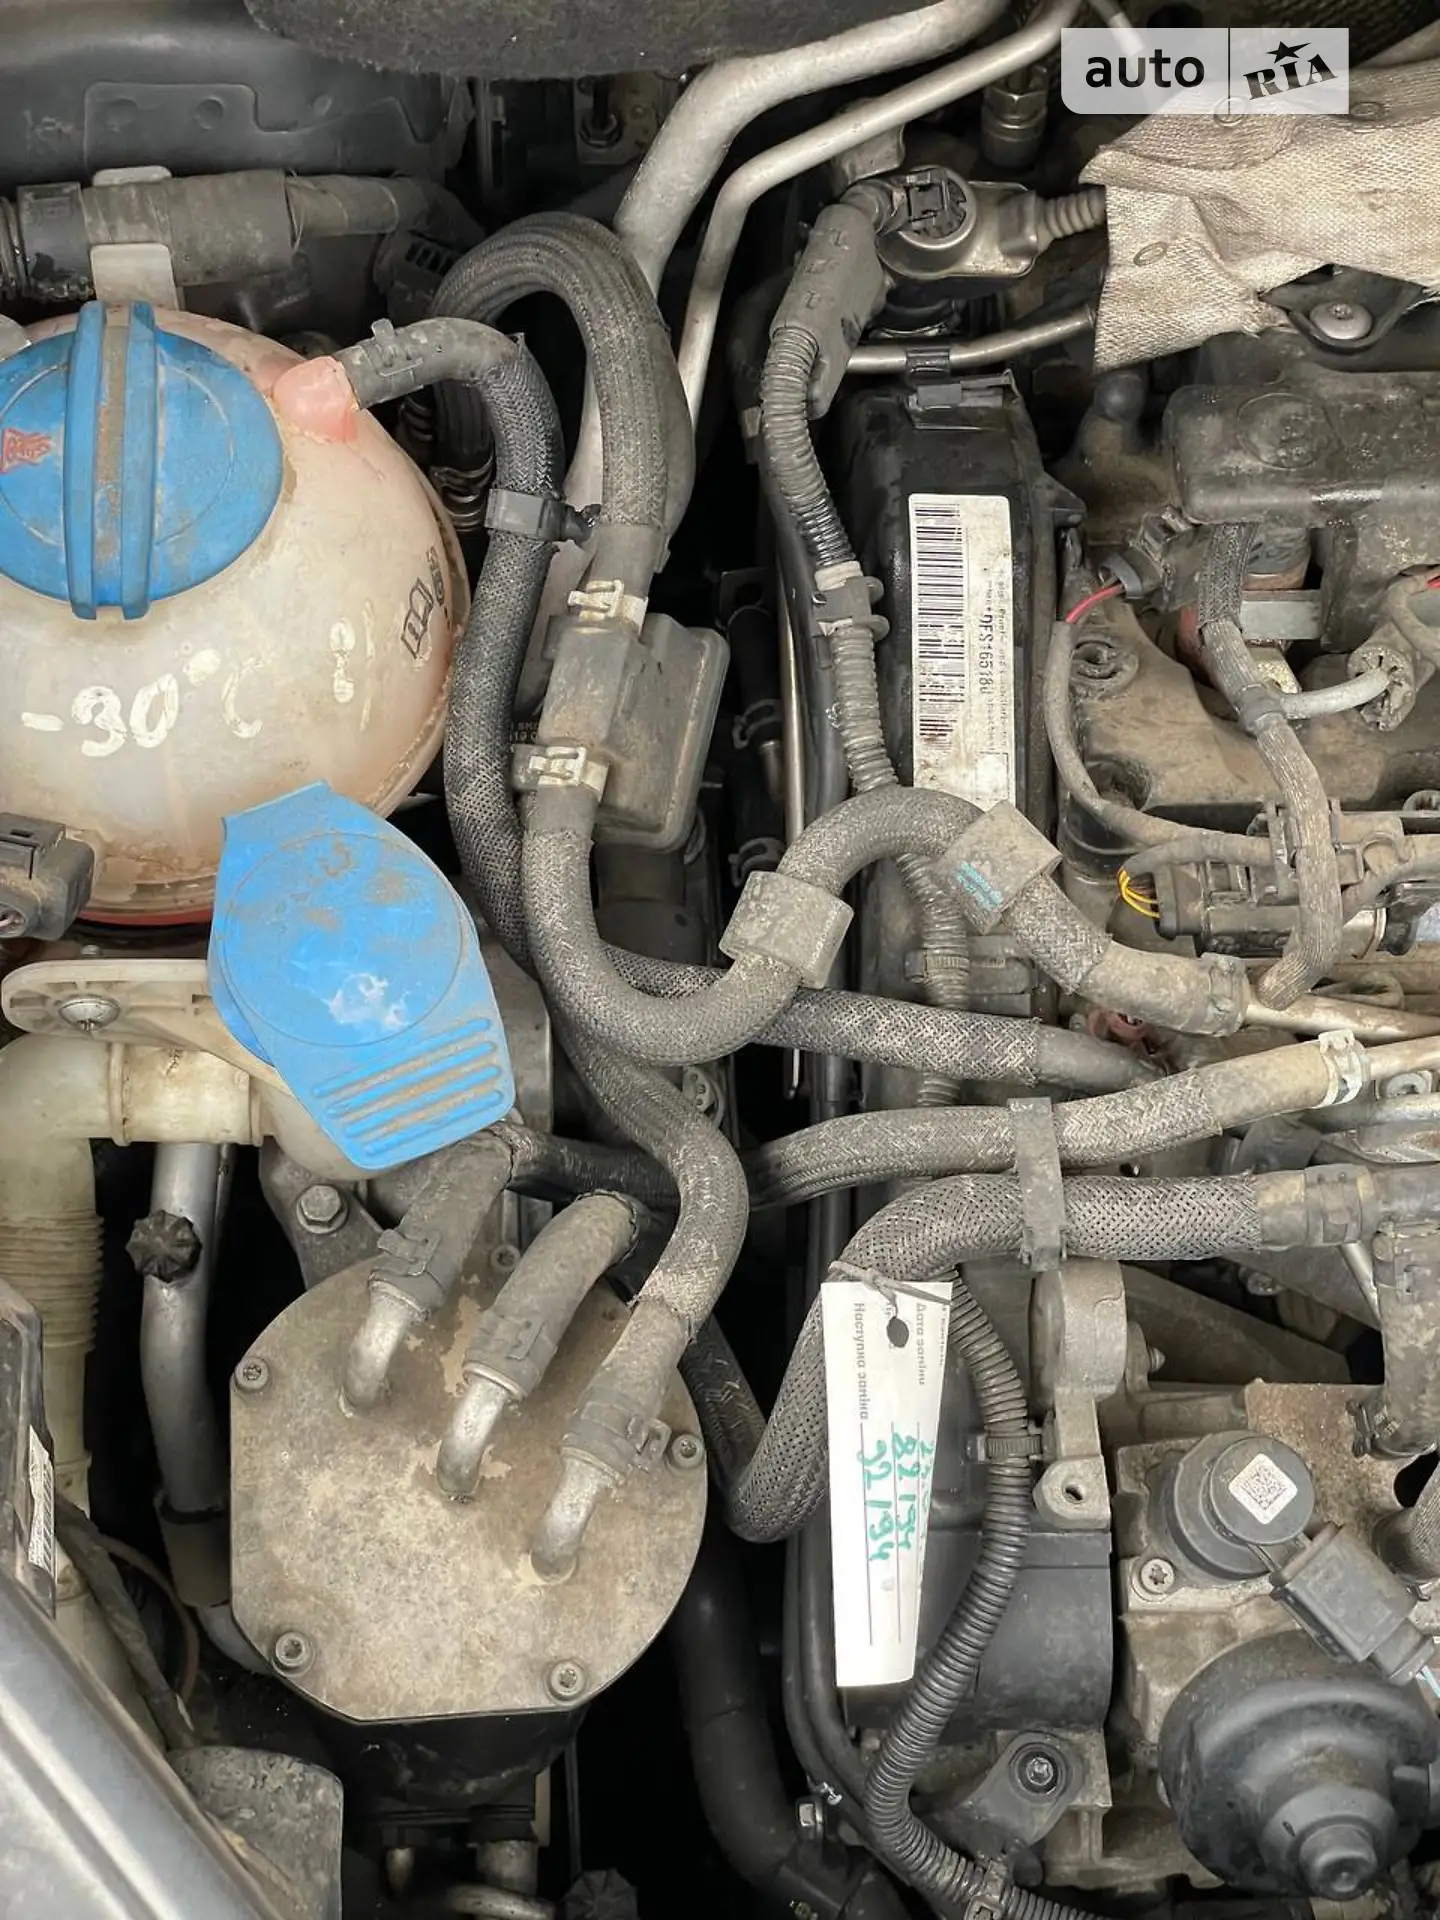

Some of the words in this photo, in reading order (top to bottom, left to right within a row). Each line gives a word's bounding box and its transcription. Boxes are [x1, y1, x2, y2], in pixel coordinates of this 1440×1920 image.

[852, 1303, 866, 1369] Наступна
[916, 1303, 926, 1336] Дата
[857, 1373, 870, 1420] заміна
